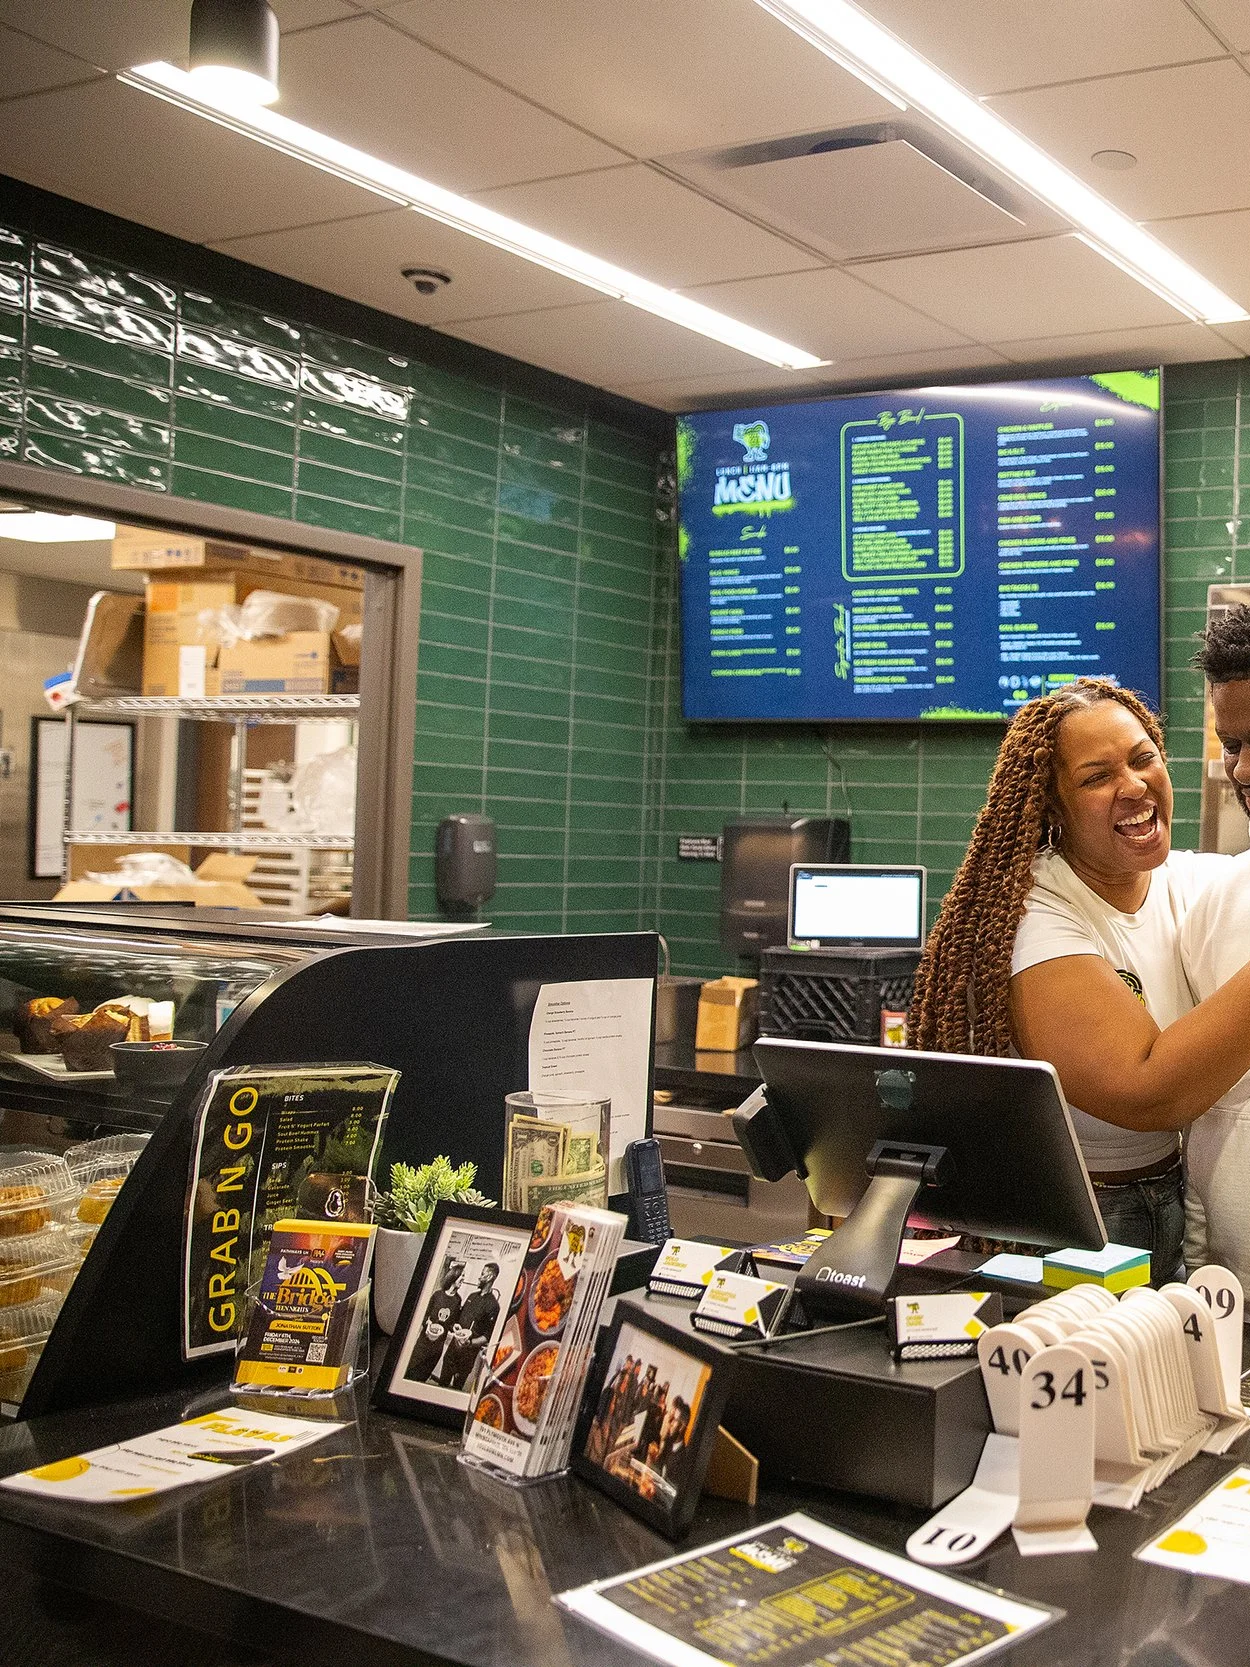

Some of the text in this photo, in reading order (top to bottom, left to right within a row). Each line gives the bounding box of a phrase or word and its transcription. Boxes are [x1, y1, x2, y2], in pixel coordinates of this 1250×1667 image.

[713, 471, 792, 506] MENU
[284, 1094, 304, 1102] BITES
[271, 1161, 287, 1170] SIPS
[208, 1087, 259, 1332] GRAB N GO
[829, 1270, 867, 1288] toast
[262, 1291, 277, 1300] THE
[276, 1286, 336, 1311] Bridge
[275, 1322, 302, 1330] JONATHAN
[987, 1344, 1030, 1376] 40
[1030, 1367, 1087, 1410] 34
[920, 1526, 977, 1552] 10
